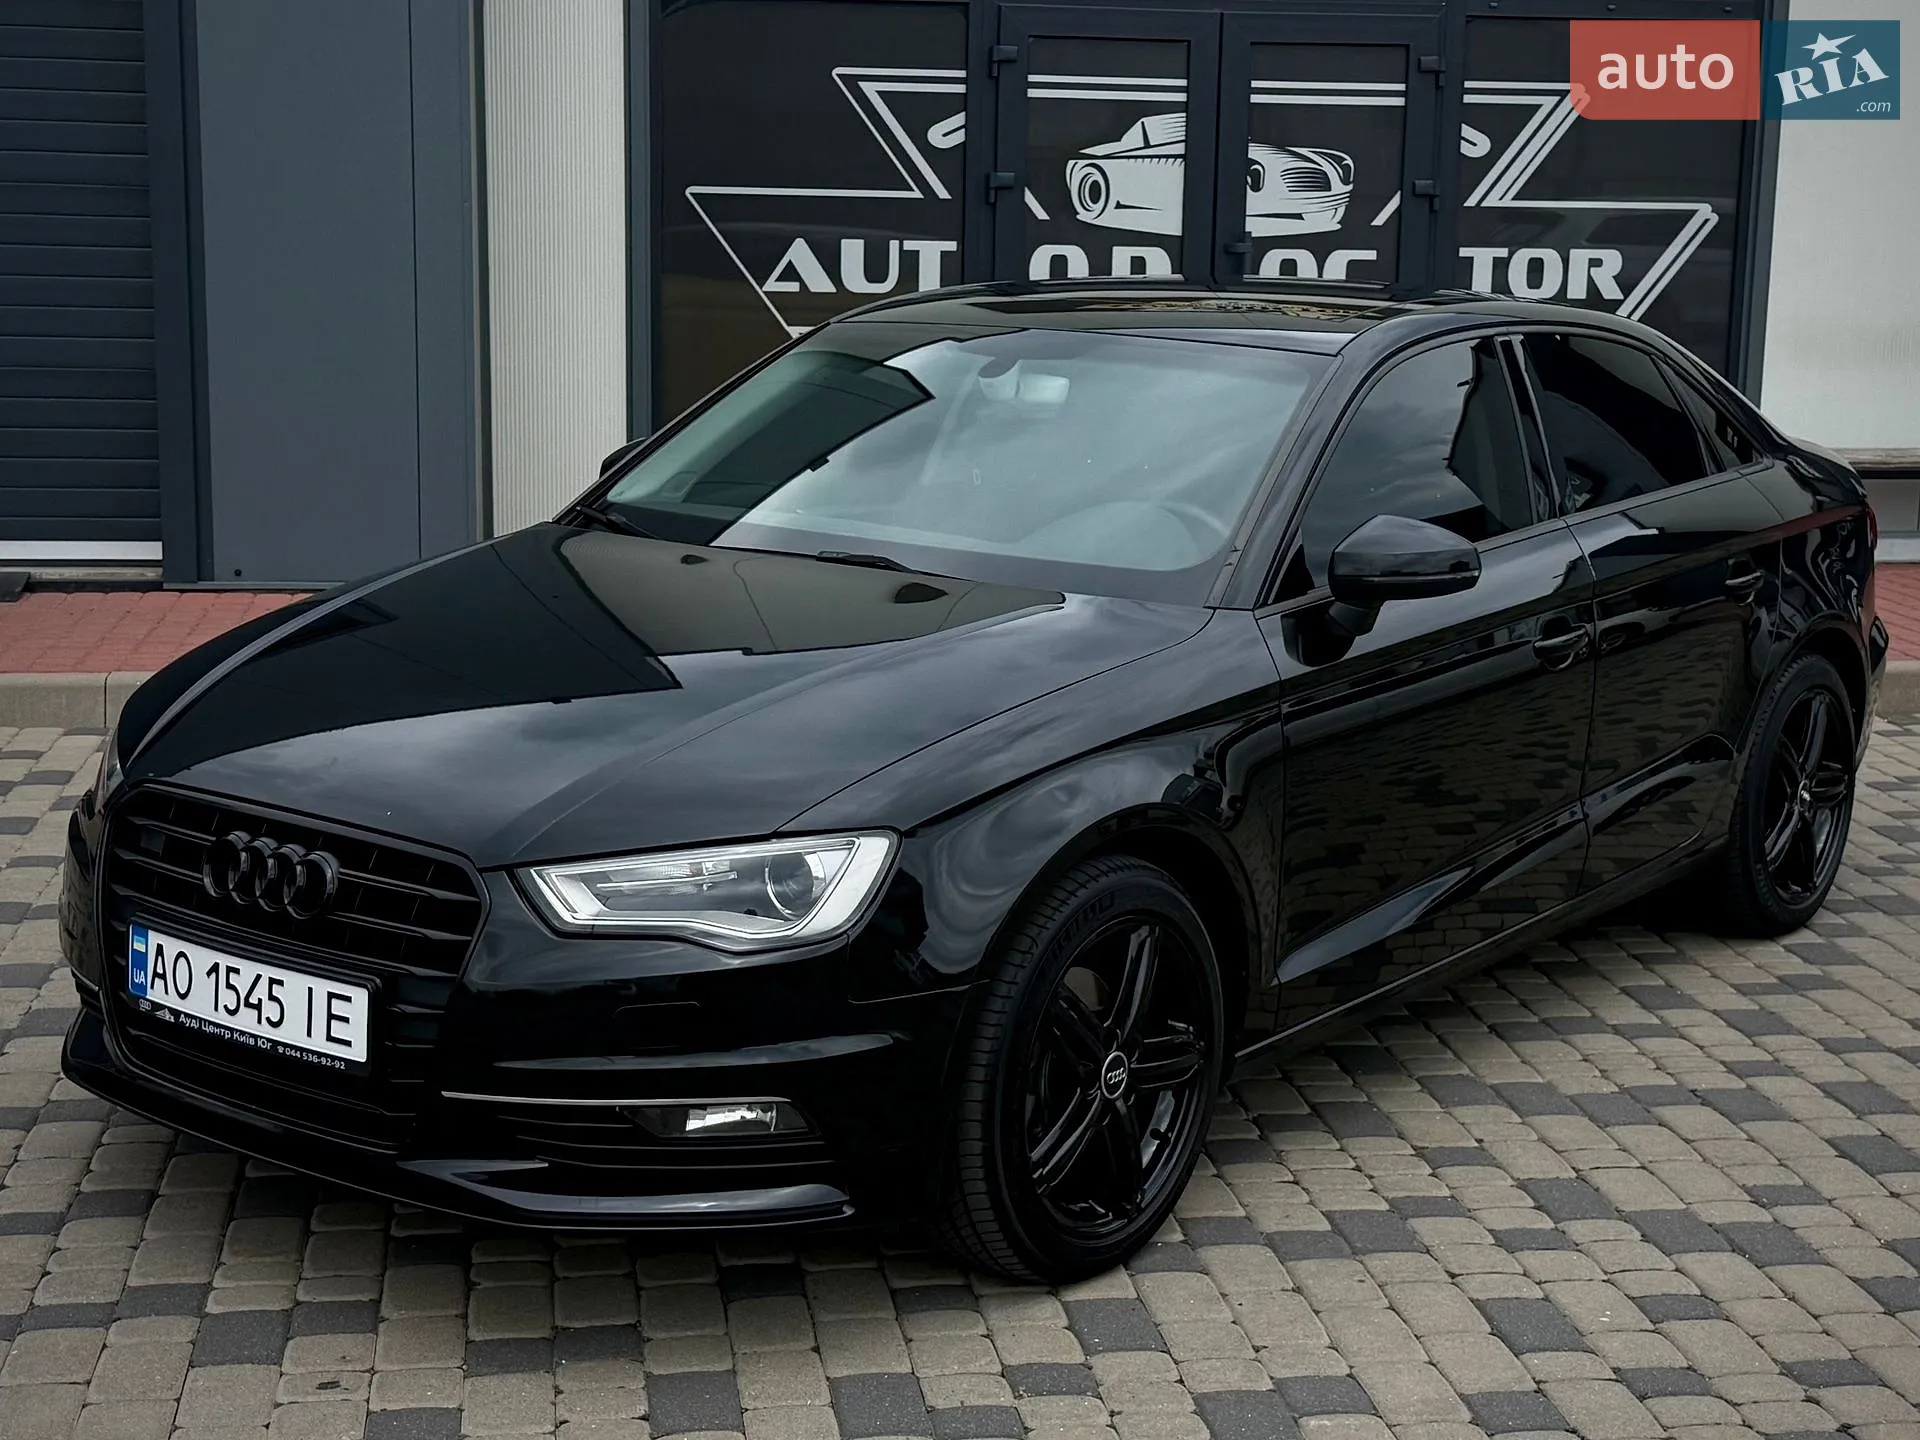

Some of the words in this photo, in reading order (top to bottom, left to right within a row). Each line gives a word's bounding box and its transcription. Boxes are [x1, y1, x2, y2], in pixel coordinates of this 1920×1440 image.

[133, 968, 146, 986] UA
[150, 942, 194, 1001] AO
[205, 961, 286, 1029] 1545
[306, 986, 353, 1048] IE
[178, 1013, 200, 1030] Ауді
[201, 1019, 232, 1040] Центр
[233, 1030, 256, 1047] Київ
[257, 1037, 273, 1050] Юг
